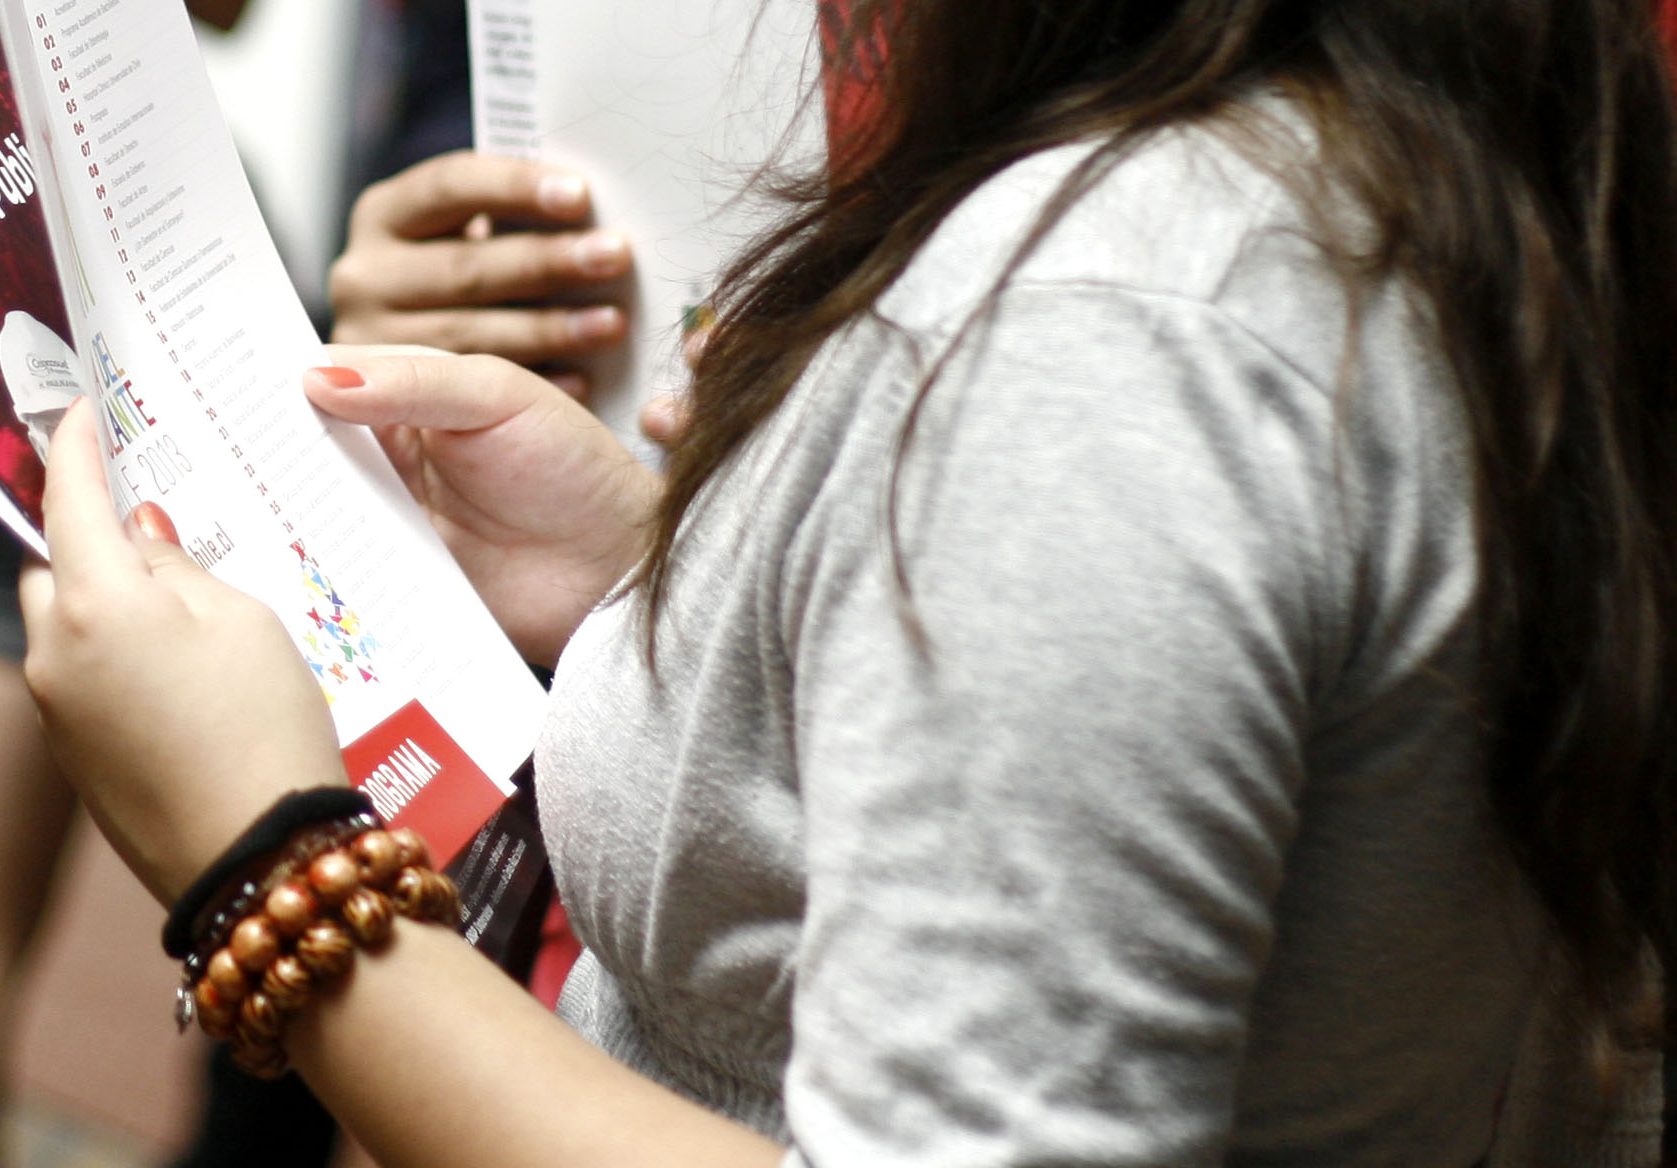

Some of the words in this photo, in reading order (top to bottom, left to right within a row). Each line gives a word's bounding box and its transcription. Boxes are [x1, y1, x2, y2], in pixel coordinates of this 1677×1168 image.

[36, 13, 47, 29] 01
[43, 34, 56, 50] 02
[51, 56, 63, 72] 03
[58, 77, 70, 93] 04
[66, 98, 78, 114] 05
[73, 120, 85, 136] 06
[81, 141, 91, 157] 07
[88, 163, 99, 179] 08
[95, 184, 106, 200] 09
[103, 206, 113, 221] 10
[110, 227, 120, 243] 11
[118, 249, 128, 264] 12
[126, 270, 136, 285] 13
[135, 290, 146, 305] 14
[145, 310, 156, 325] 15
[157, 330, 168, 344] 16
[169, 349, 179, 364] 17
[101, 379, 157, 460] LANTE
[218, 426, 230, 440] 21
[231, 444, 243, 459] 22
[137, 434, 193, 495] 2013
[244, 463, 255, 478] 23
[256, 482, 268, 496] 24
[269, 500, 281, 515] 25
[282, 520, 294, 533] 26
[187, 521, 235, 570] hile.cl
[358, 737, 442, 822] ROGRAMA
